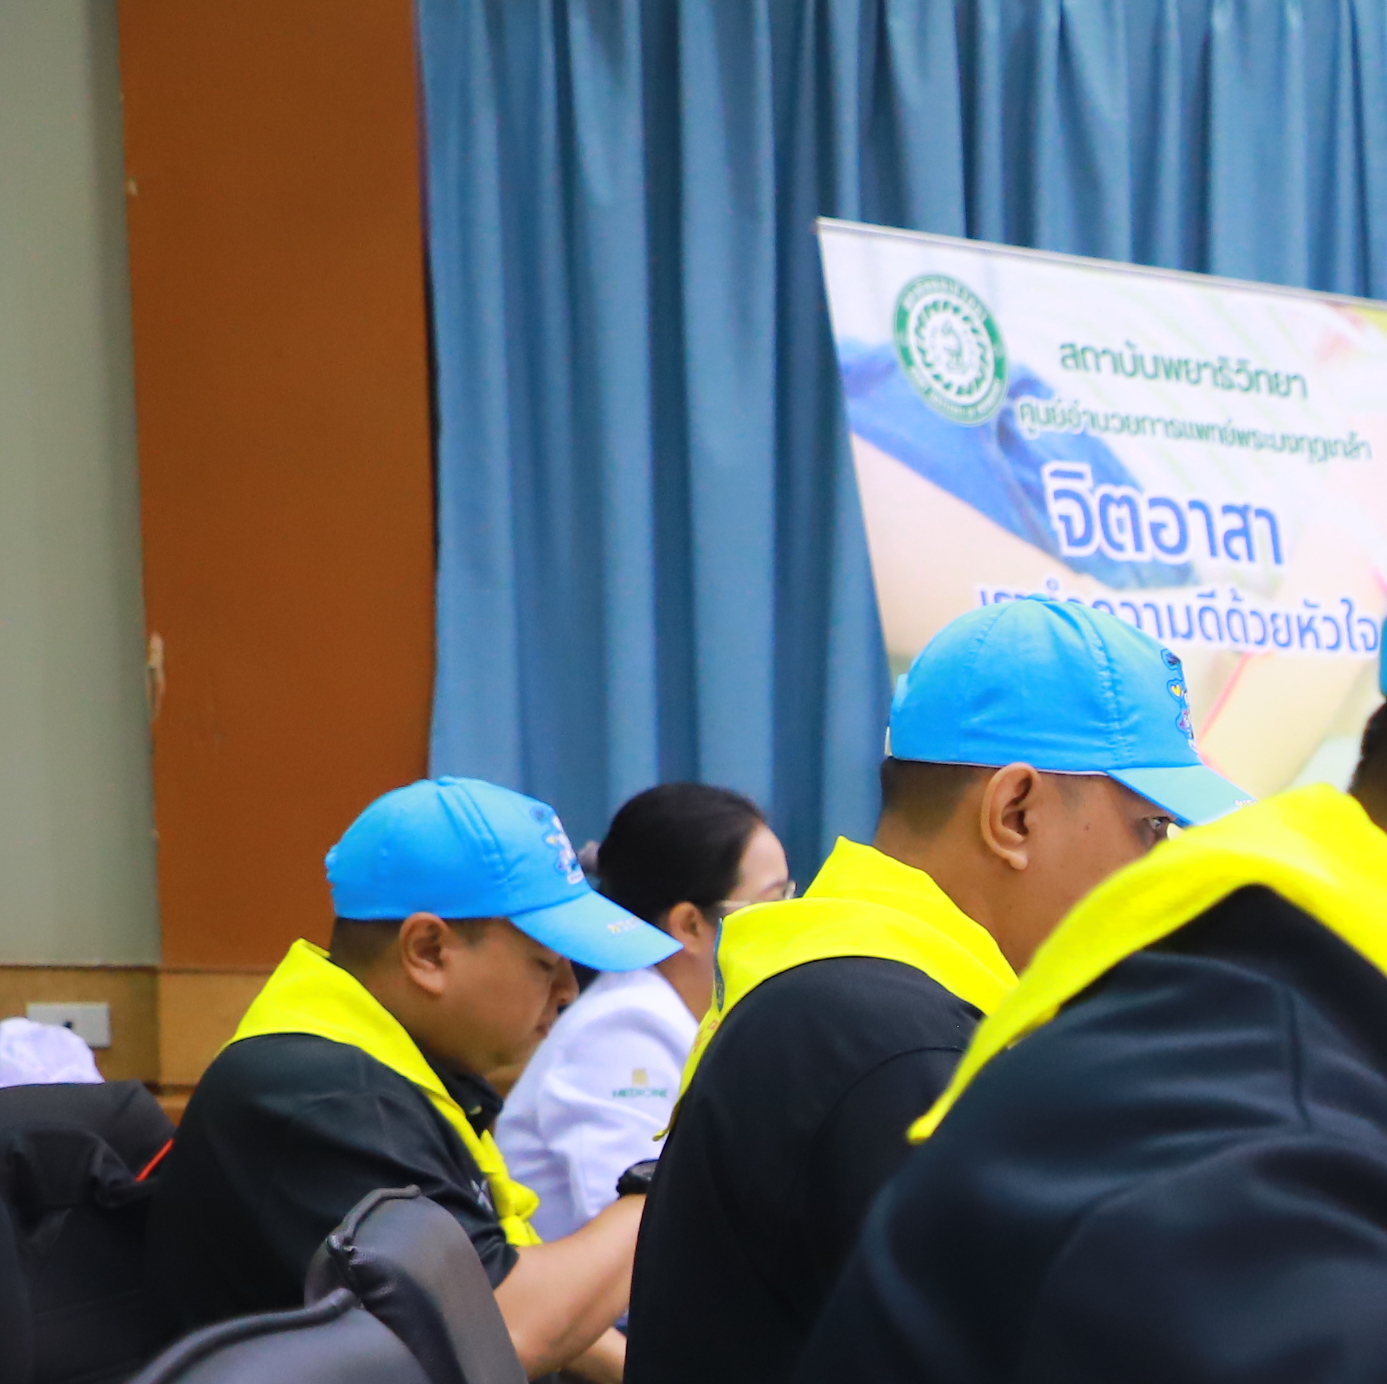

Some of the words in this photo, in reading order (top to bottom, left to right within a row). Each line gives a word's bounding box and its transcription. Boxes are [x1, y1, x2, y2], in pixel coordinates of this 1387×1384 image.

[1058, 340, 1309, 399] สถาบันพยาธิวิทยา
[1047, 466, 1284, 566] จิตอาสา
